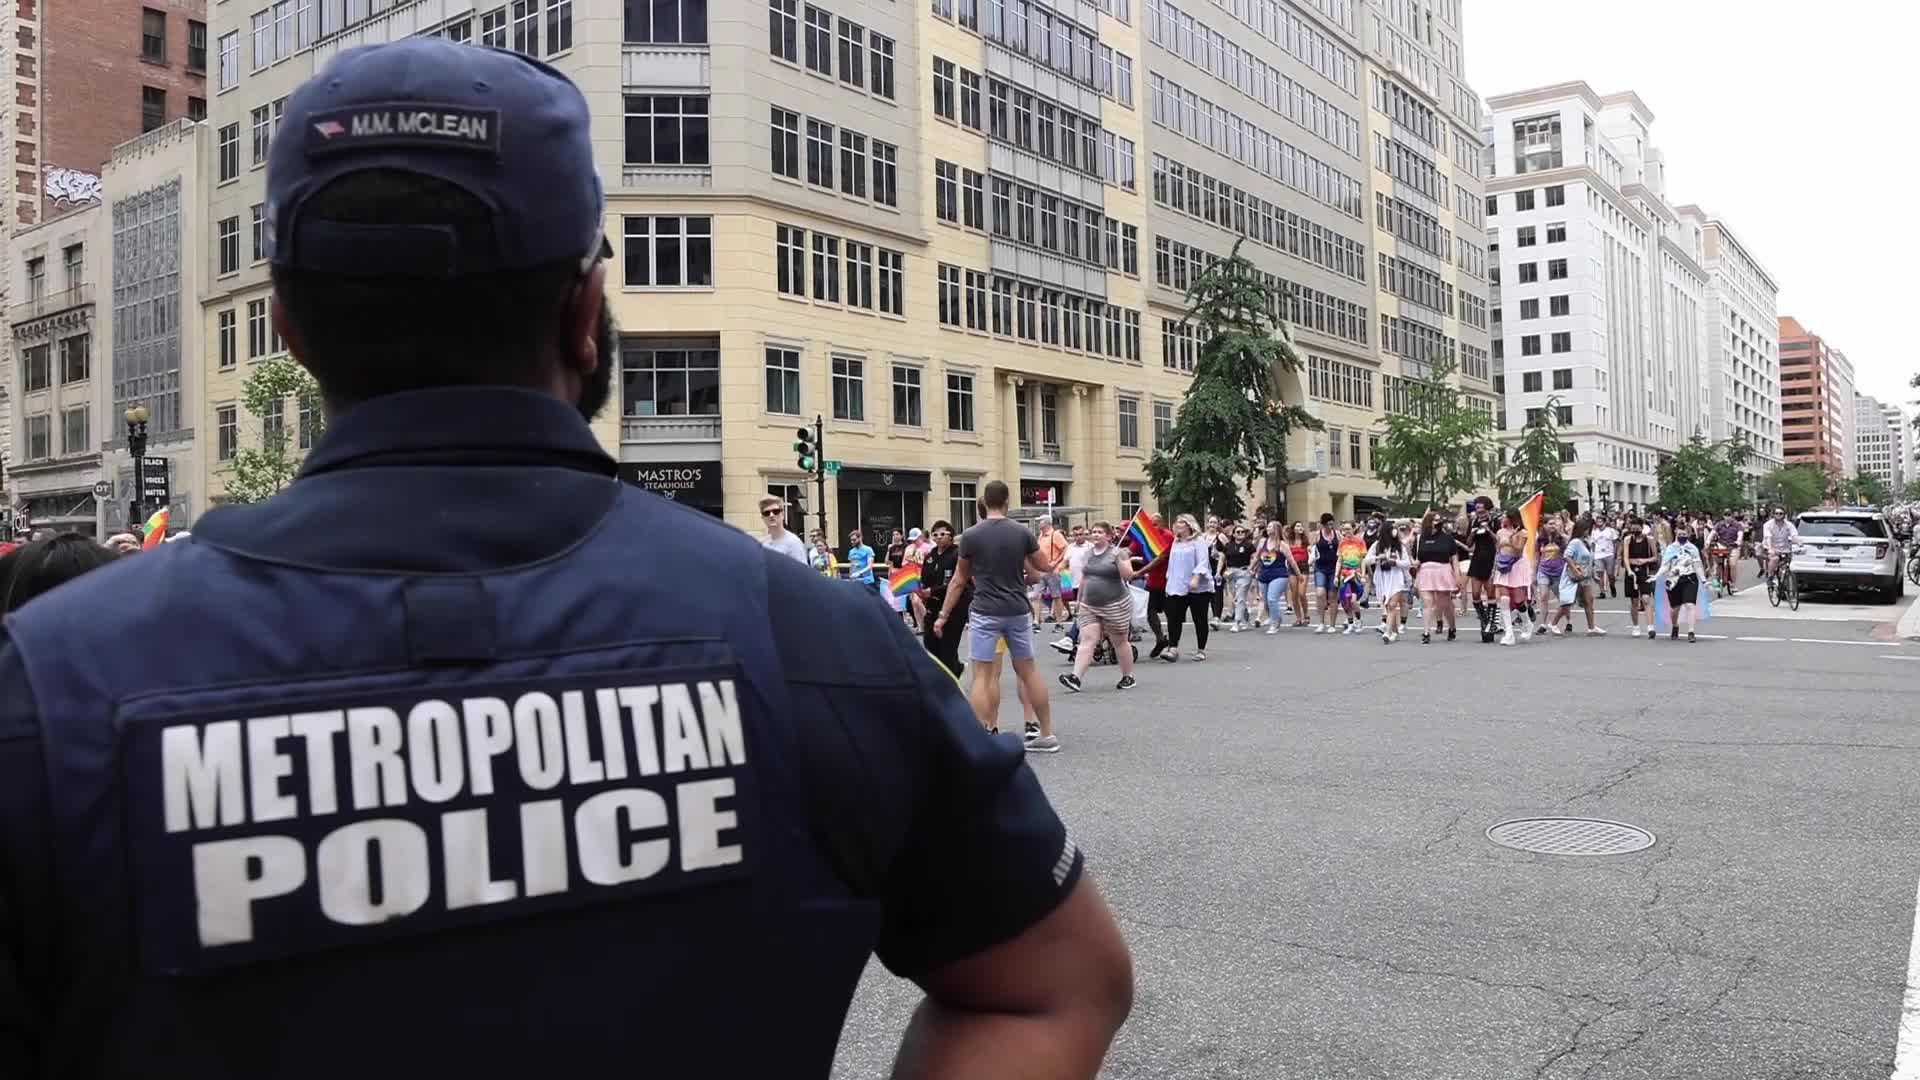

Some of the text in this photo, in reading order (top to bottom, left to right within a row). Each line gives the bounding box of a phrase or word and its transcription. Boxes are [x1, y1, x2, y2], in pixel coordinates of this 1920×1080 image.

[398, 112, 487, 141] MCLEAN
[144, 458, 164, 466] BLACK
[145, 476, 165, 484] VOICES
[637, 468, 702, 481] MASTRO'S
[145, 489, 166, 497] MATTER
[161, 680, 746, 833] METROPOLITAN
[192, 777, 743, 948] POLICE
